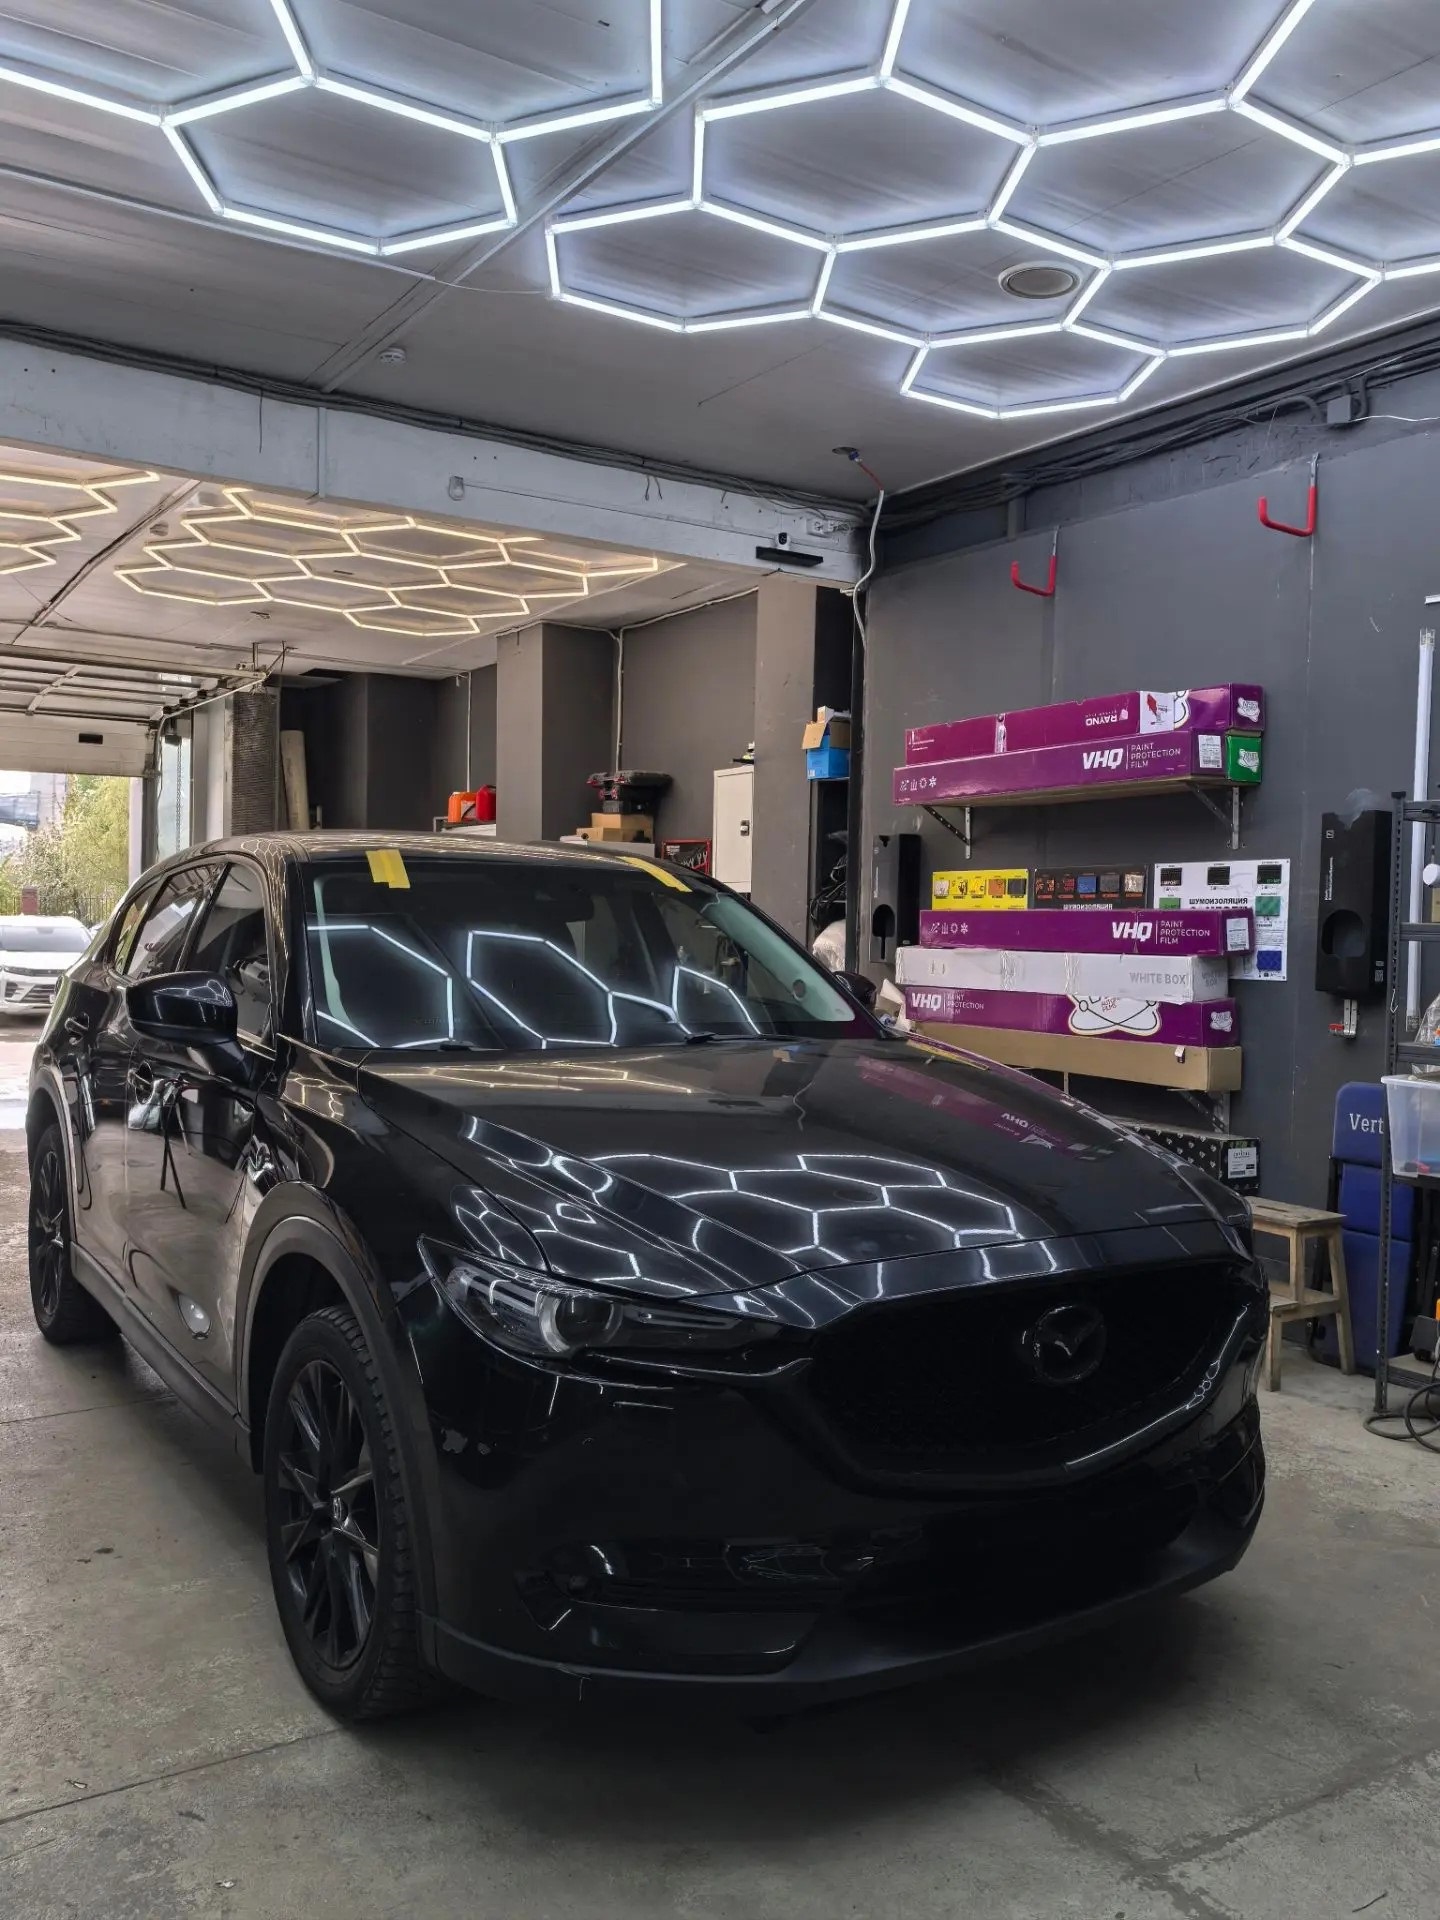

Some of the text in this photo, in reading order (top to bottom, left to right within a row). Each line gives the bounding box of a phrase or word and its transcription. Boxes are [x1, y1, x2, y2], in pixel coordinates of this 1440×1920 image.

[1085, 714, 1118, 726] RAYNO
[1131, 742, 1155, 751] PAINT
[1083, 748, 1124, 770] VHQ
[1131, 748, 1181, 760] PROTECTION
[1131, 760, 1149, 769] FILM
[1189, 897, 1248, 905] ШУМОИЗОЛЯЦИЯ
[1160, 920, 1184, 928] PAINT
[1112, 922, 1153, 942] VHQ
[1160, 928, 1211, 937] PROTECTION
[1160, 936, 1179, 944] FILM
[1129, 972, 1187, 985] WHITE BOX
[911, 992, 942, 1011] VHQ
